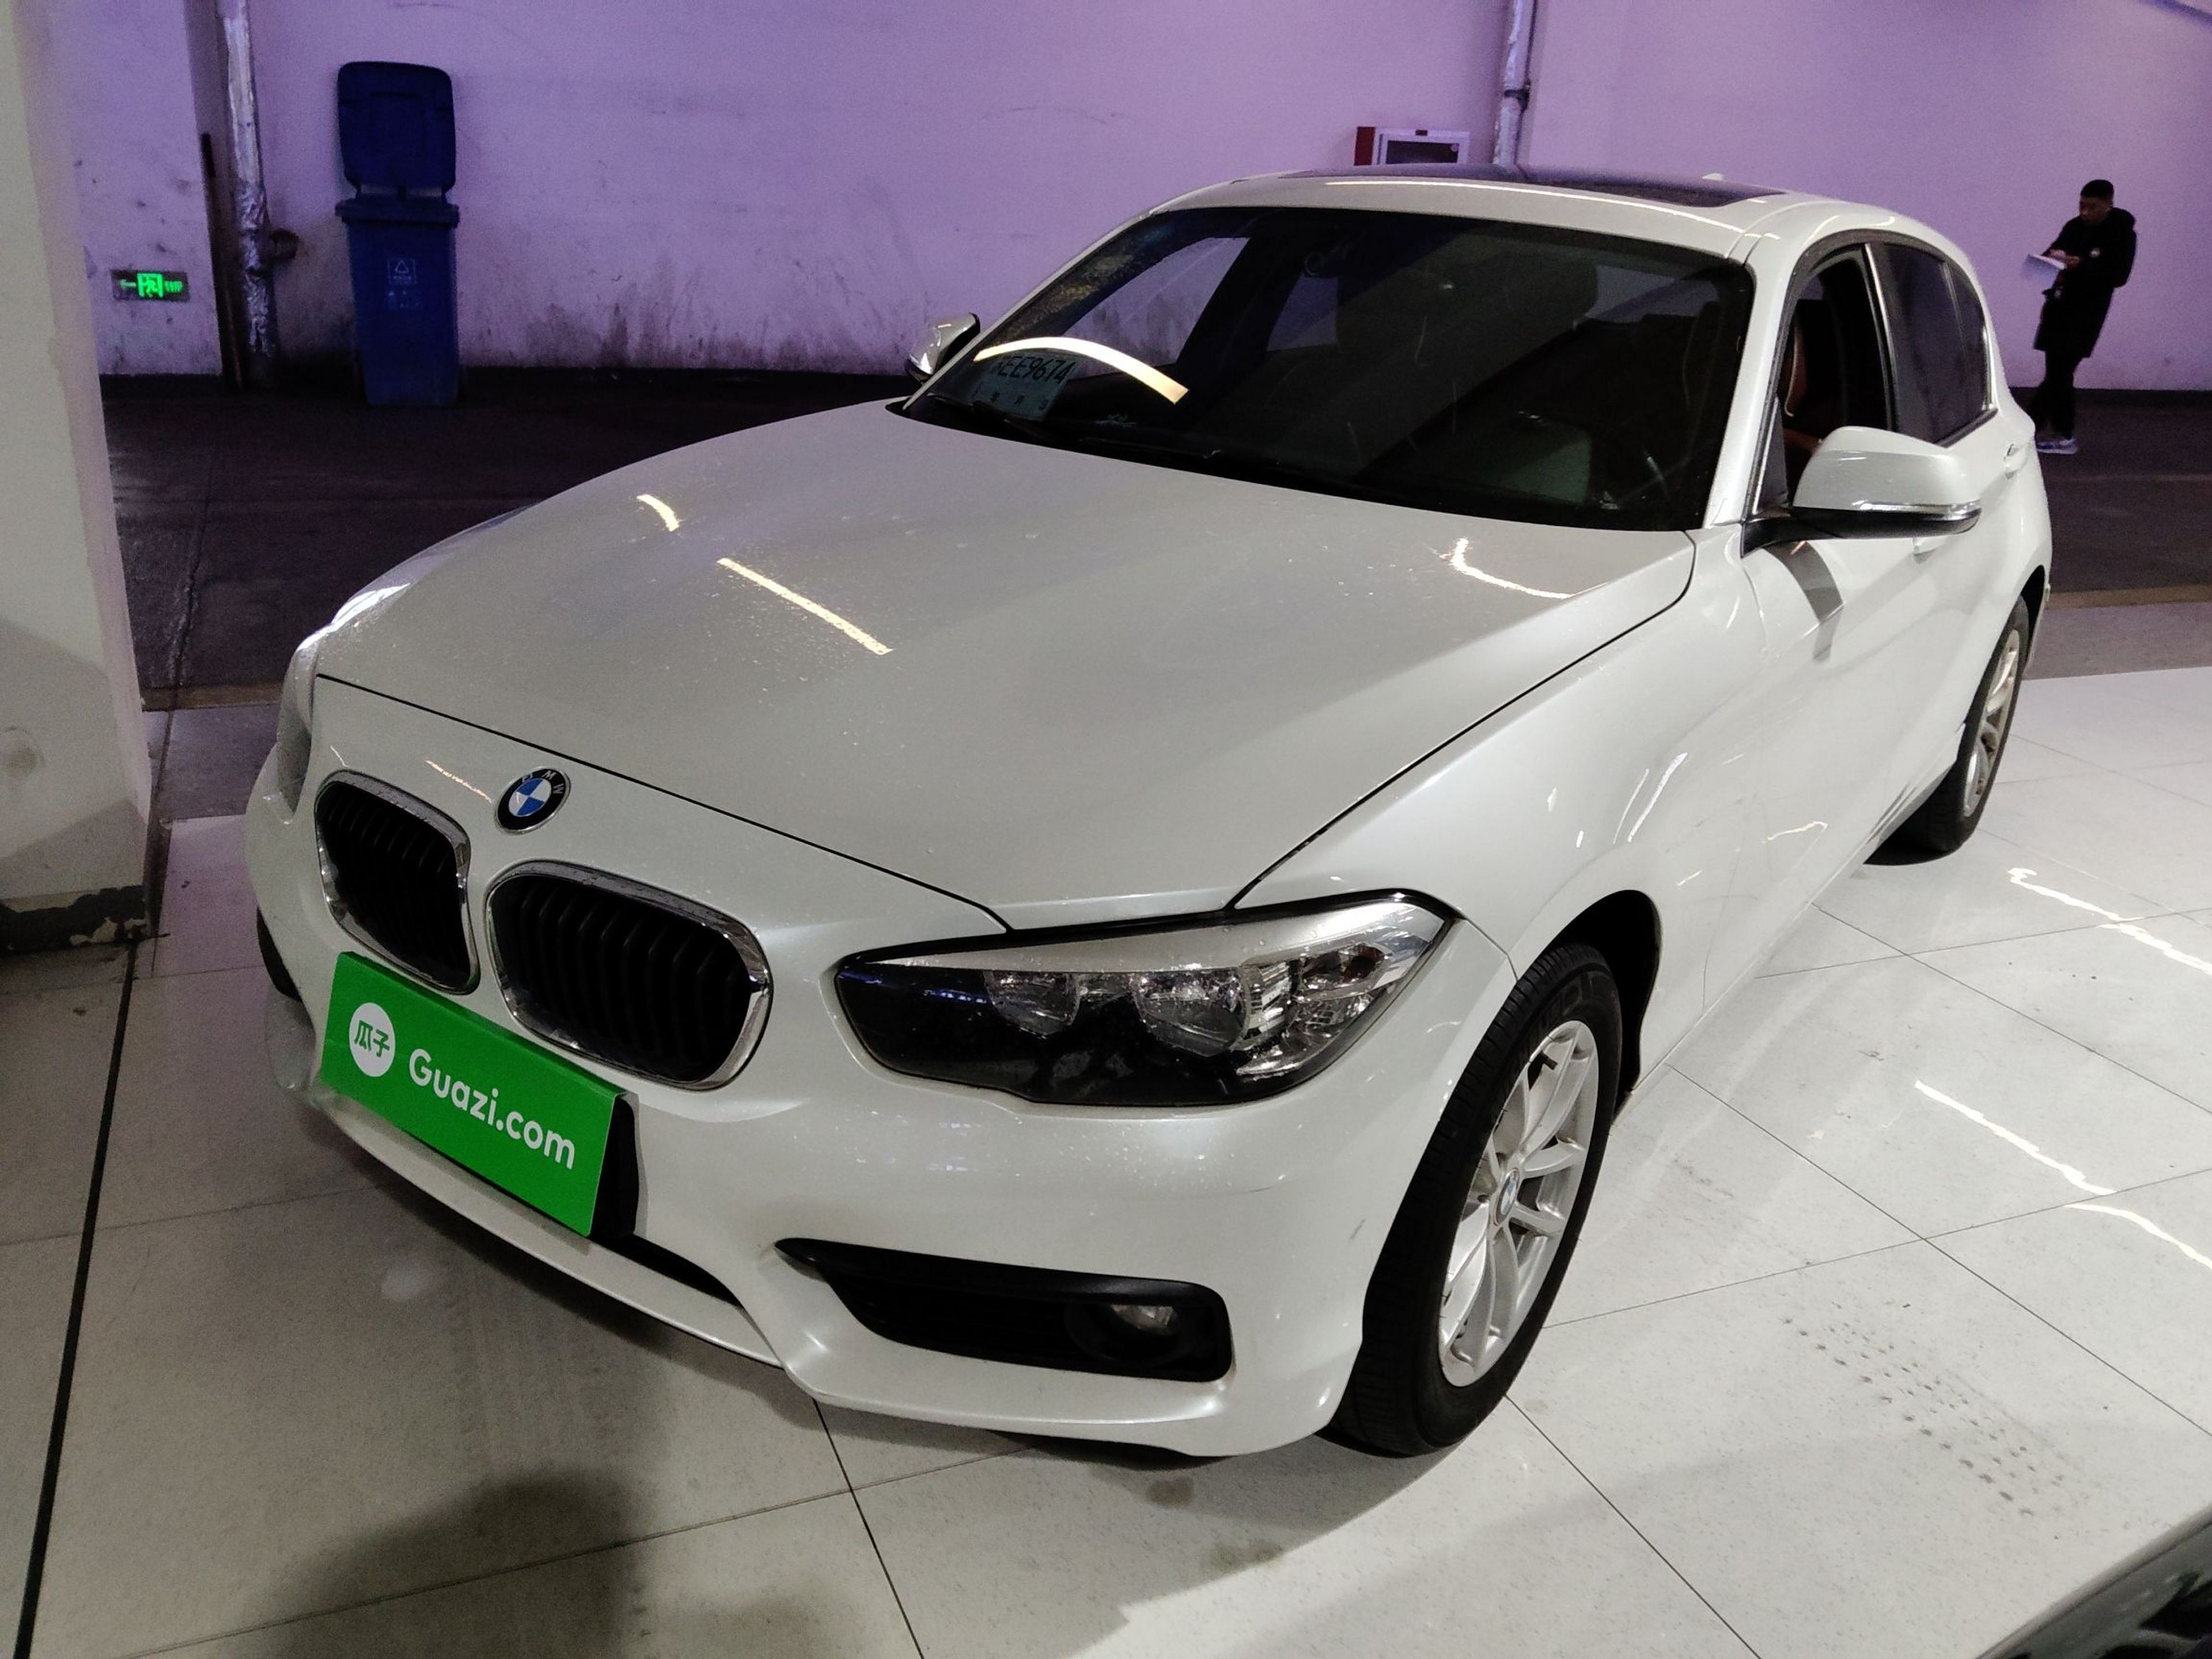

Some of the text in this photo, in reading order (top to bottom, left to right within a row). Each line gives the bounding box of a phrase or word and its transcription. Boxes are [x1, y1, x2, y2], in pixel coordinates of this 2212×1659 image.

[521, 770, 565, 794] BMW
[354, 1019, 391, 1058] 瓜子
[408, 1048, 575, 1170] Guazi.com
